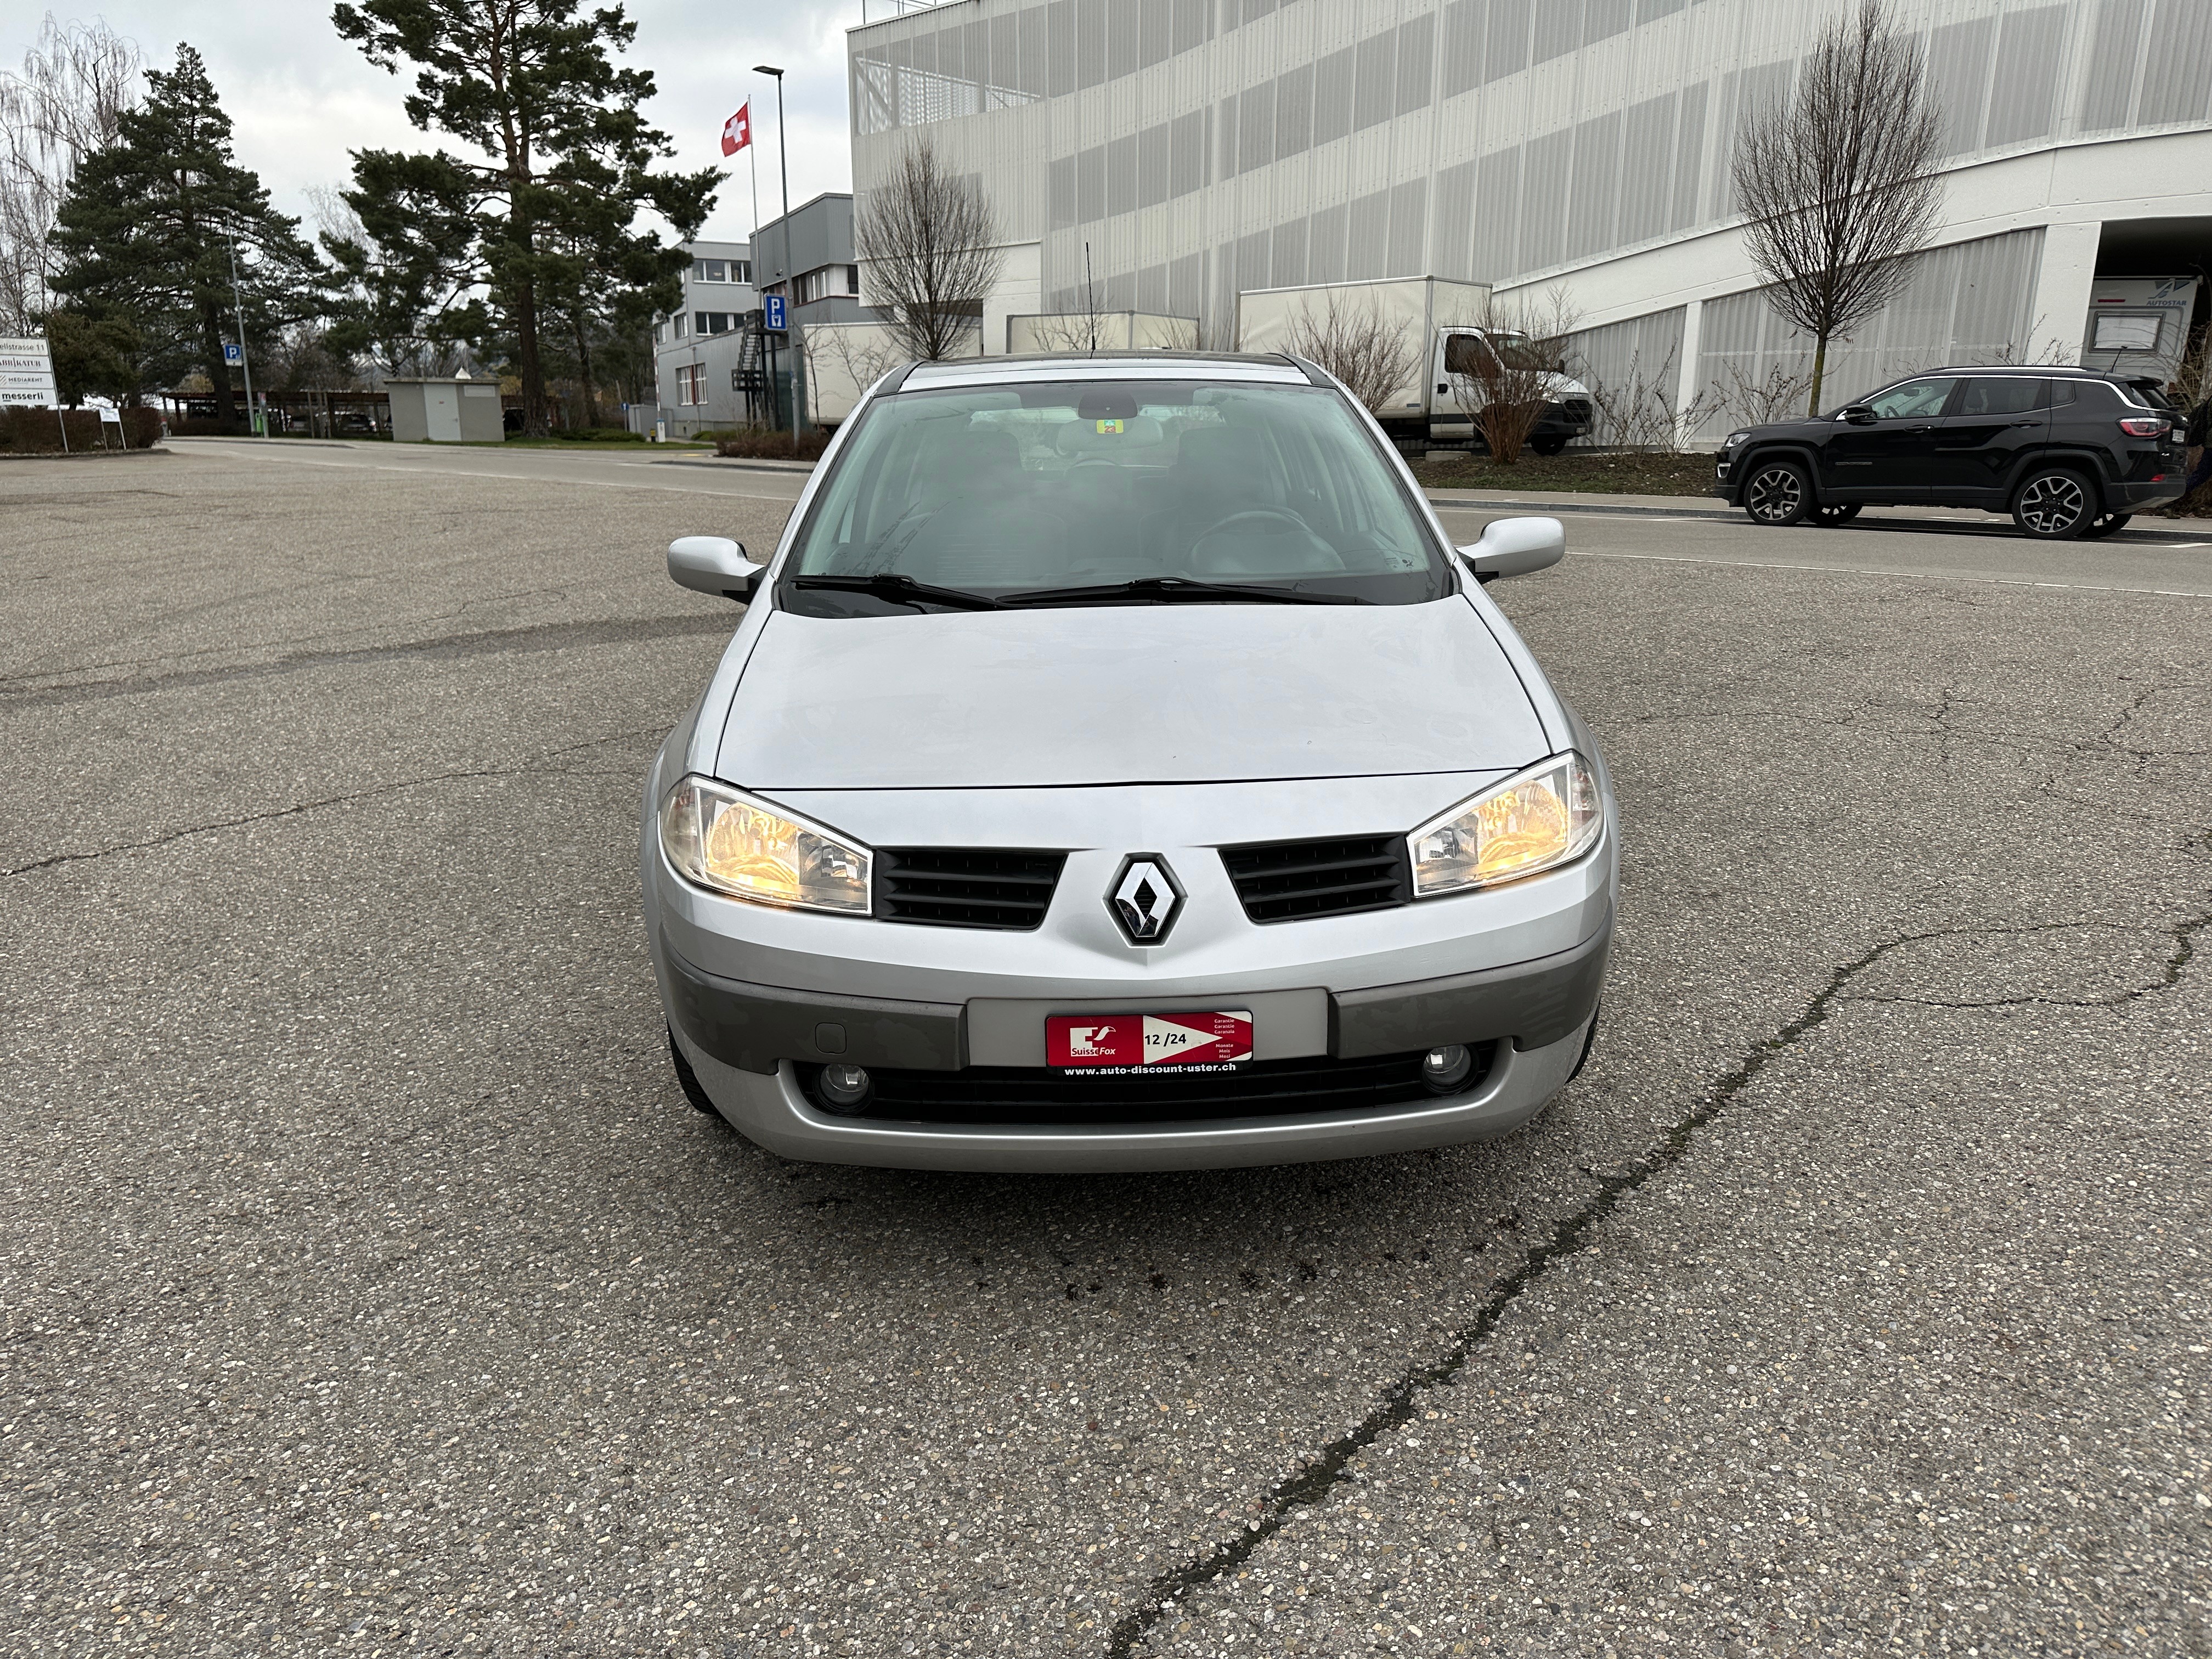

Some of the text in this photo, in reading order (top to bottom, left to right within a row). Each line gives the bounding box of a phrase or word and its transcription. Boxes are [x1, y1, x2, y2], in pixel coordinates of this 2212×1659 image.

[771, 298, 780, 314] P
[229, 347, 237, 358] P
[2, 392, 44, 400] messerli
[1144, 1032, 1187, 1047] 12 /24
[1071, 1046, 1116, 1056] SuisseFox
[1065, 1063, 1236, 1076] www.auto-discount-uster.ch
